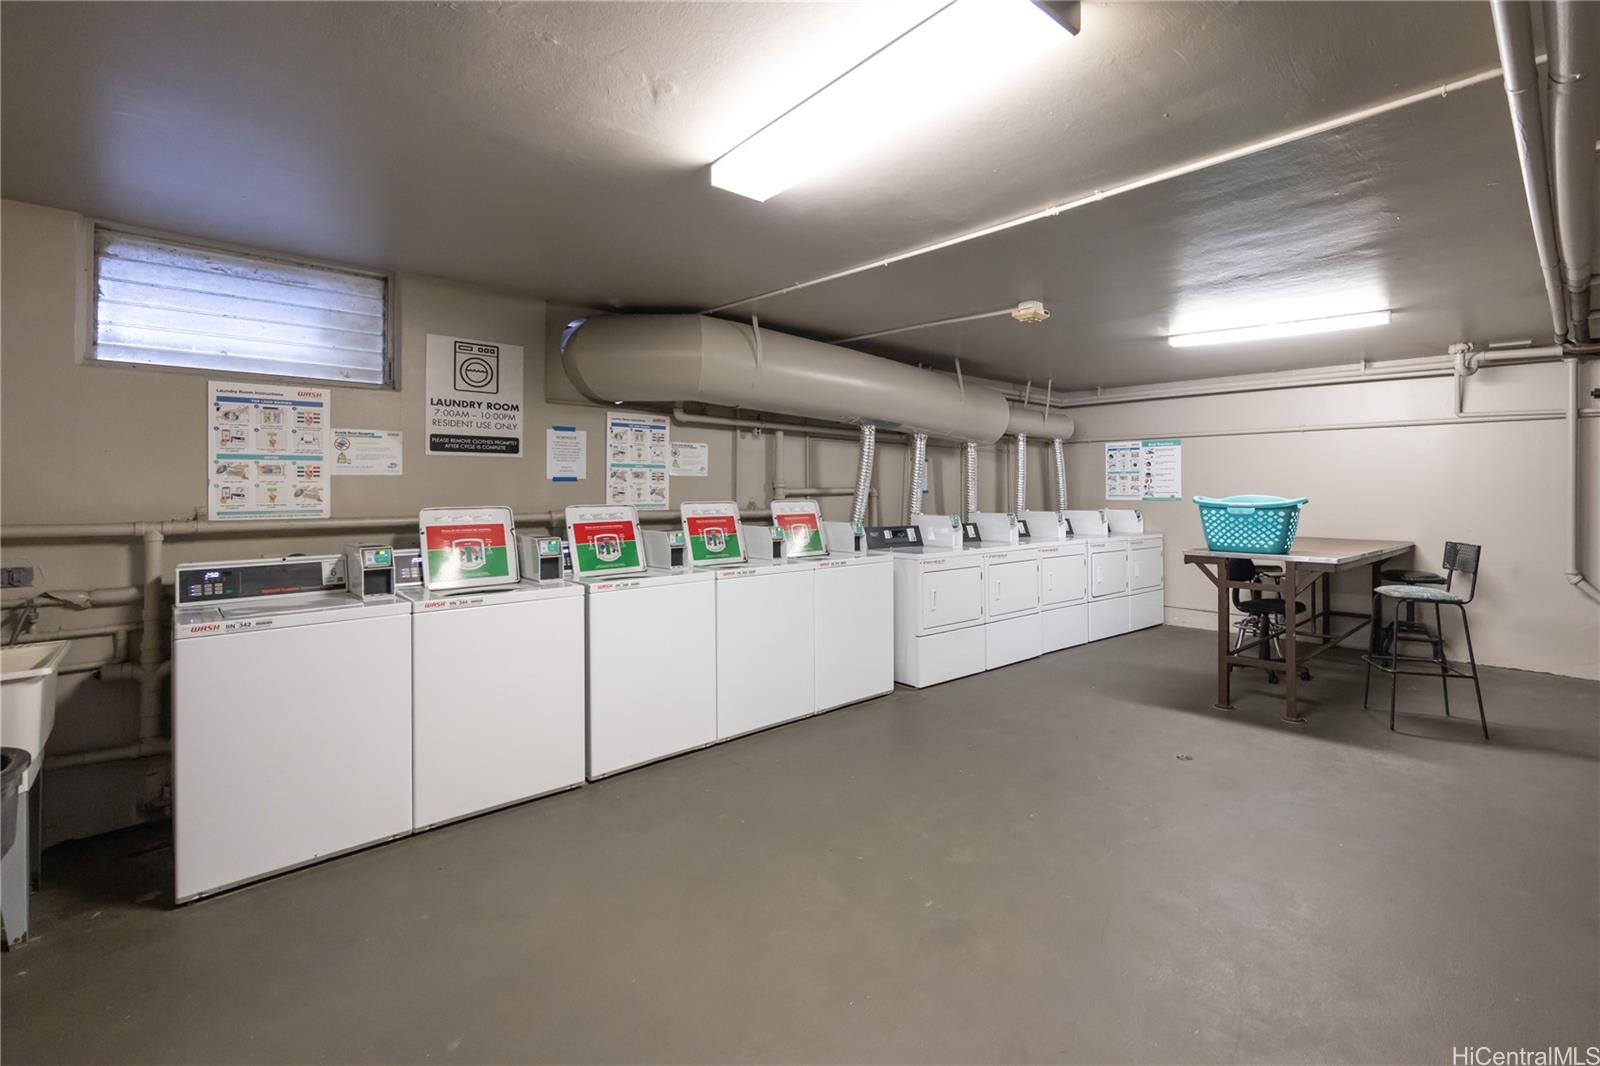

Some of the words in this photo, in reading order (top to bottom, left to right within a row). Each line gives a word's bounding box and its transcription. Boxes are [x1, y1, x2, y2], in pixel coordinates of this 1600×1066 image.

[430, 398, 483, 409] LAUNDRY
[487, 402, 520, 412] ROOM
[433, 409, 470, 418] 7:00AM
[481, 412, 516, 421] 10:00PM
[432, 418, 473, 428] RESIDENT
[476, 420, 492, 429] USE
[494, 422, 518, 431] ONLY
[190, 624, 220, 633] WASH
